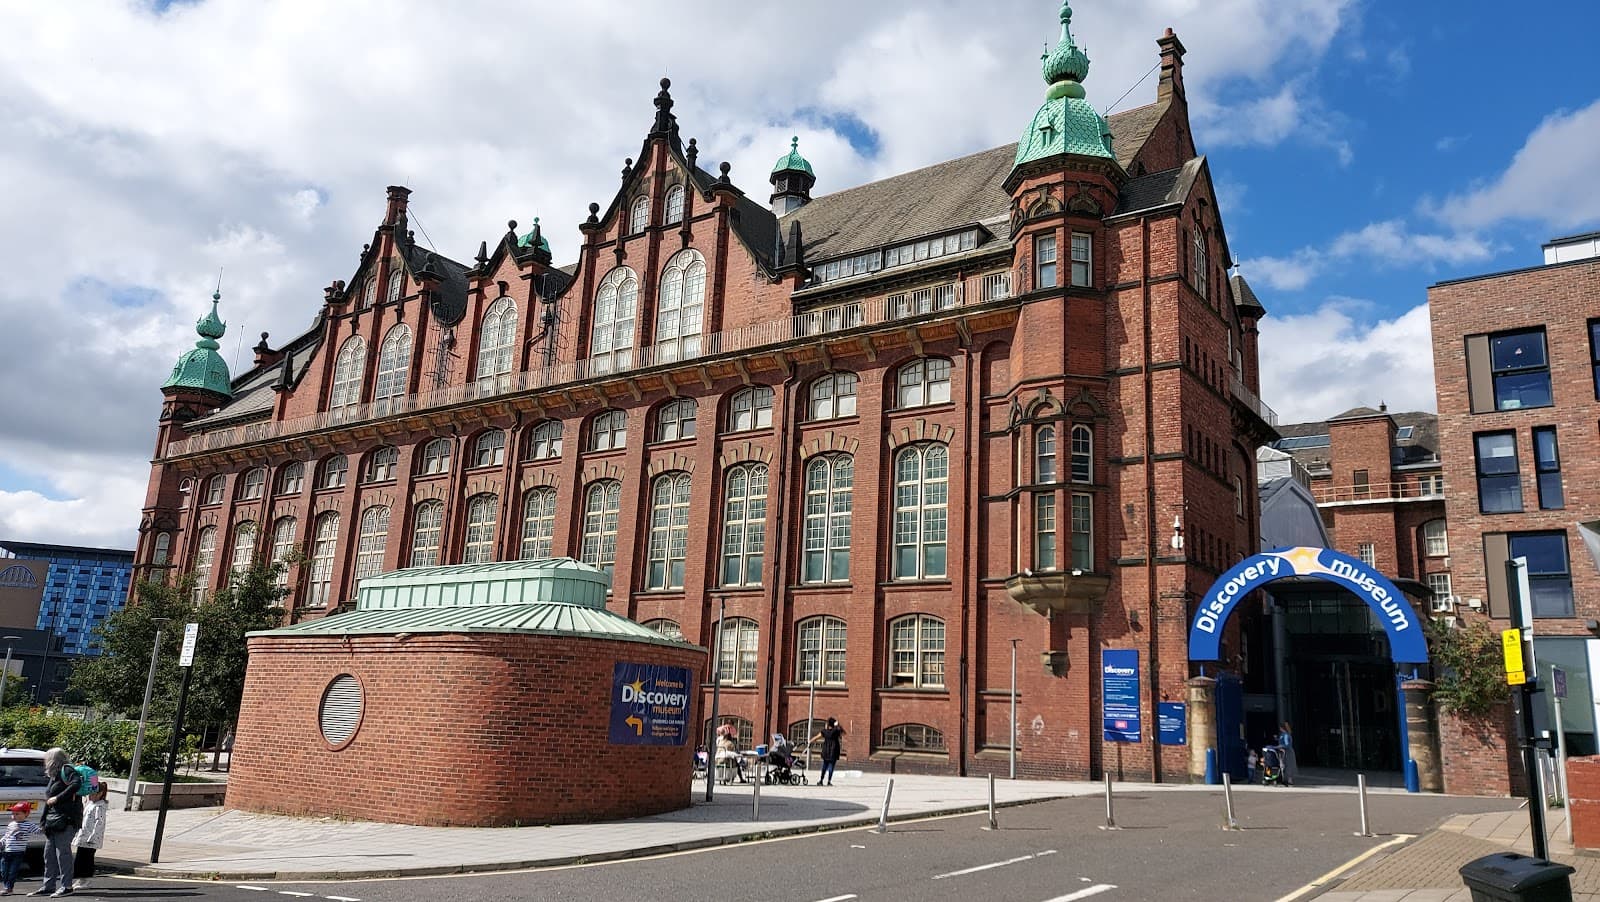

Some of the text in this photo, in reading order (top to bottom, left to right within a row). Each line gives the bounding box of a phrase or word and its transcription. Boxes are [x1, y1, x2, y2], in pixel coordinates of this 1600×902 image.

[1196, 557, 1409, 634] Discovery museum
[622, 685, 687, 710] Discovery
[653, 706, 681, 714] museum
